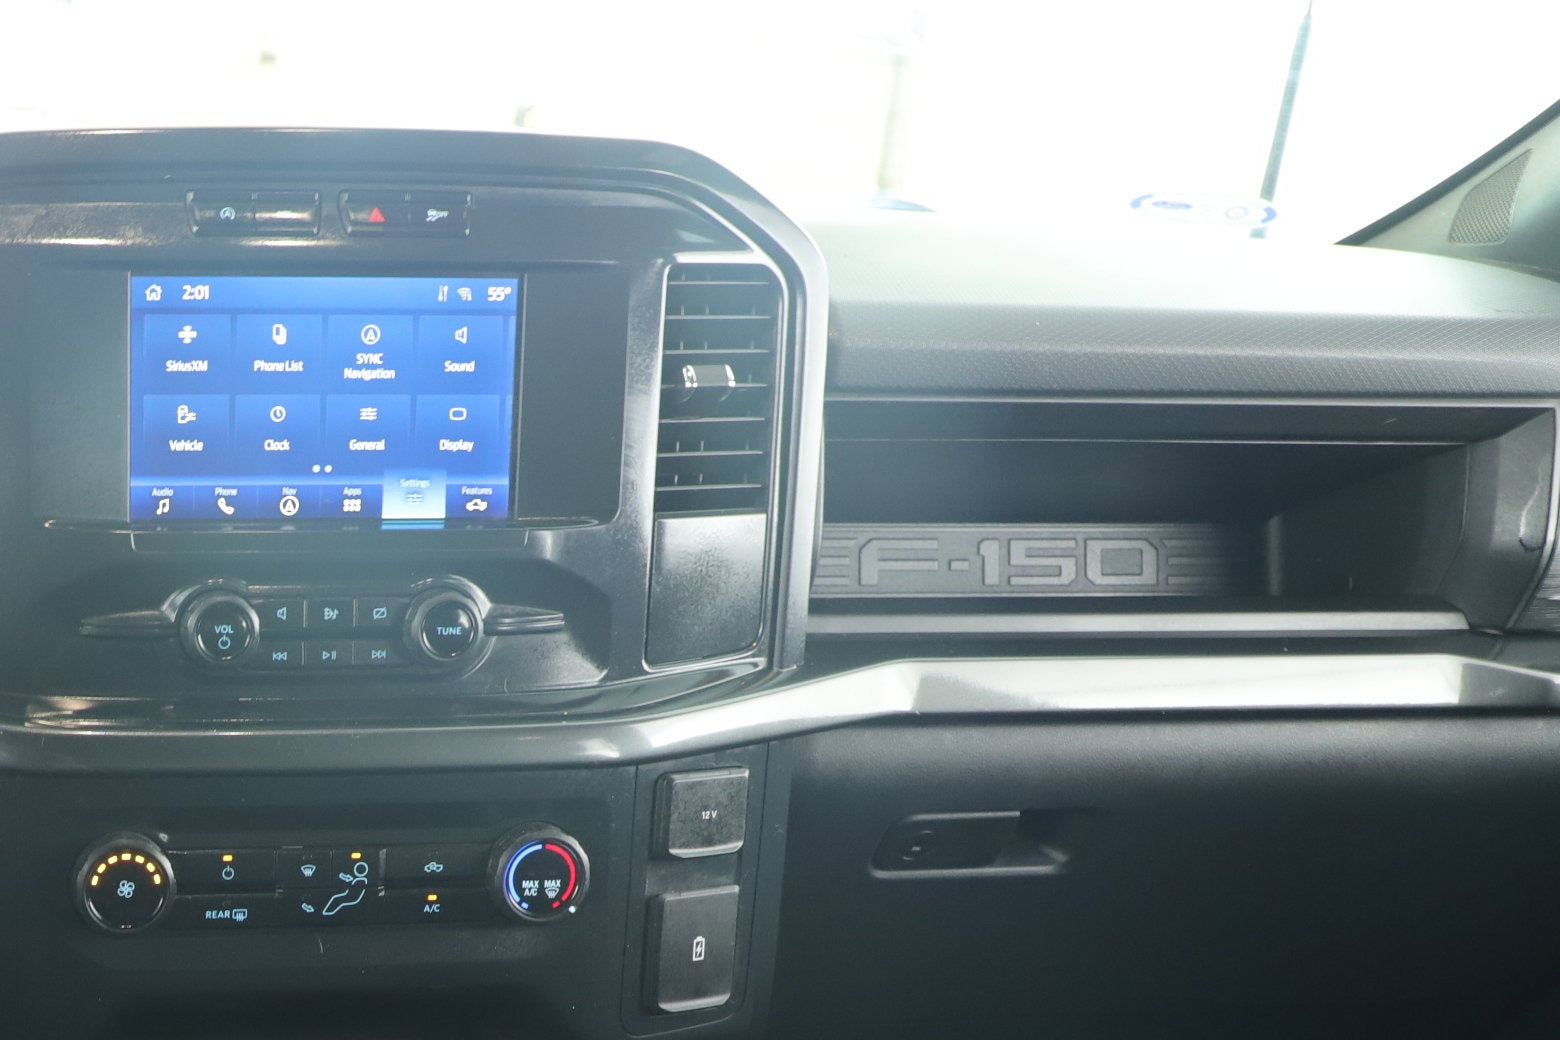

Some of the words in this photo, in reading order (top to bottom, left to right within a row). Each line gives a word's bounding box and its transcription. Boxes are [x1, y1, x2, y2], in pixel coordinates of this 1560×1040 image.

[182, 285, 210, 300] 2:01
[356, 353, 383, 365] SYNC
[166, 360, 208, 372] SiriusXM
[254, 360, 285, 372] Phone
[285, 360, 304, 372] List
[444, 360, 475, 372] Sound
[344, 367, 395, 381] Navigation
[169, 439, 203, 451] Vehicle
[264, 439, 290, 451] Clock
[349, 439, 385, 451] General
[439, 439, 474, 452] Display
[400, 478, 430, 489] Settings
[152, 487, 174, 497] Audio
[215, 486, 237, 496] Phone
[282, 486, 297, 496] Nav
[343, 486, 362, 497] Apps
[461, 486, 493, 495] Features
[859, 538, 1159, 586] F-150
[214, 625, 234, 635] VOL
[436, 626, 462, 636] TUNE
[522, 880, 539, 888] MAX
[544, 879, 561, 888] MAX
[524, 888, 538, 896] A/C
[424, 903, 440, 913] A/C
[205, 909, 230, 919] REAR
